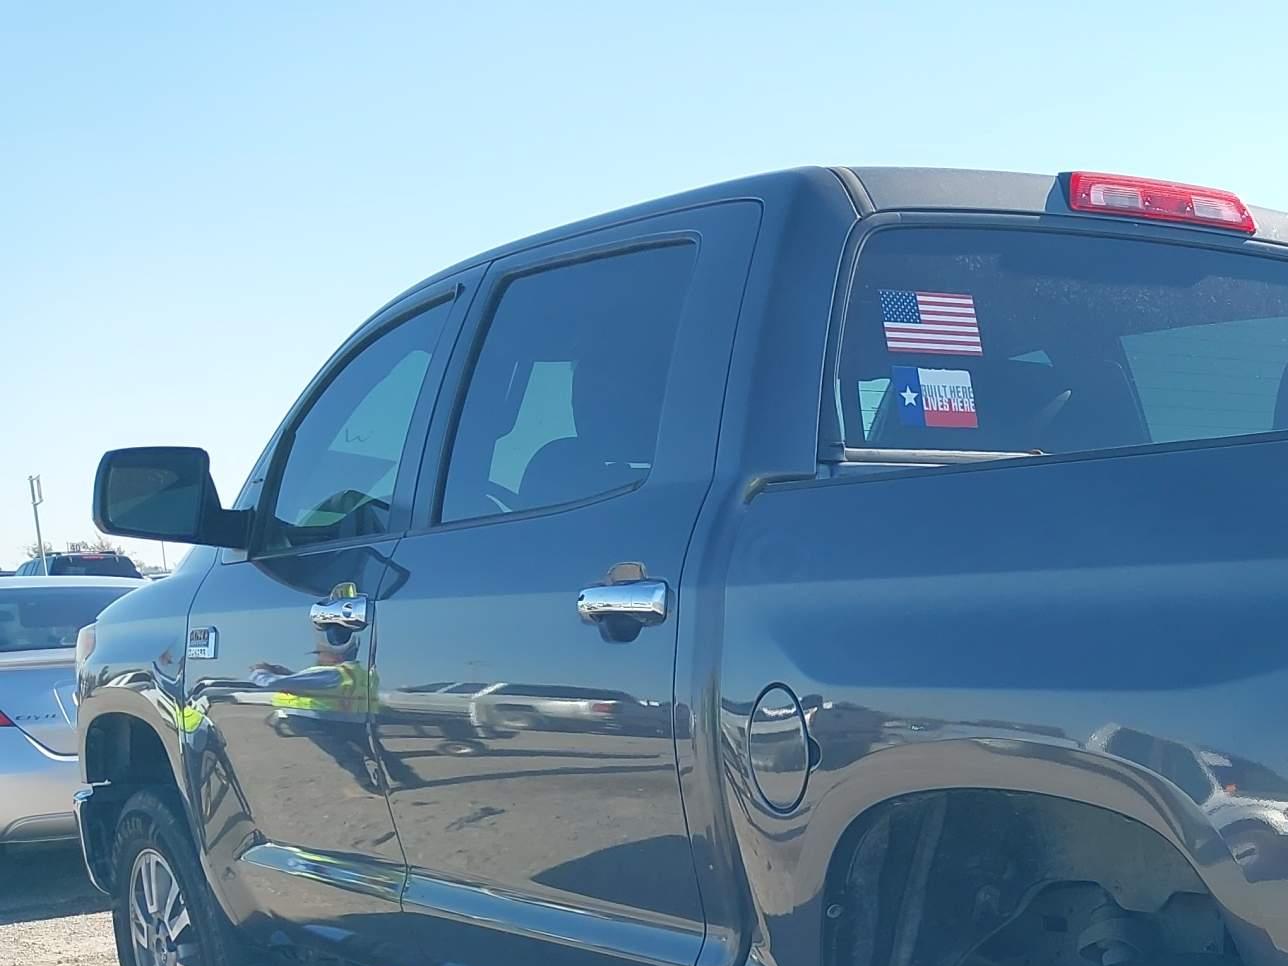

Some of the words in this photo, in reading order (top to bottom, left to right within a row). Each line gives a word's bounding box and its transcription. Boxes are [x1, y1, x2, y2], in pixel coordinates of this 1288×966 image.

[921, 384, 948, 399] BUILT
[949, 385, 974, 400] HERE
[922, 396, 949, 411] LIVES
[950, 398, 976, 413] HERE
